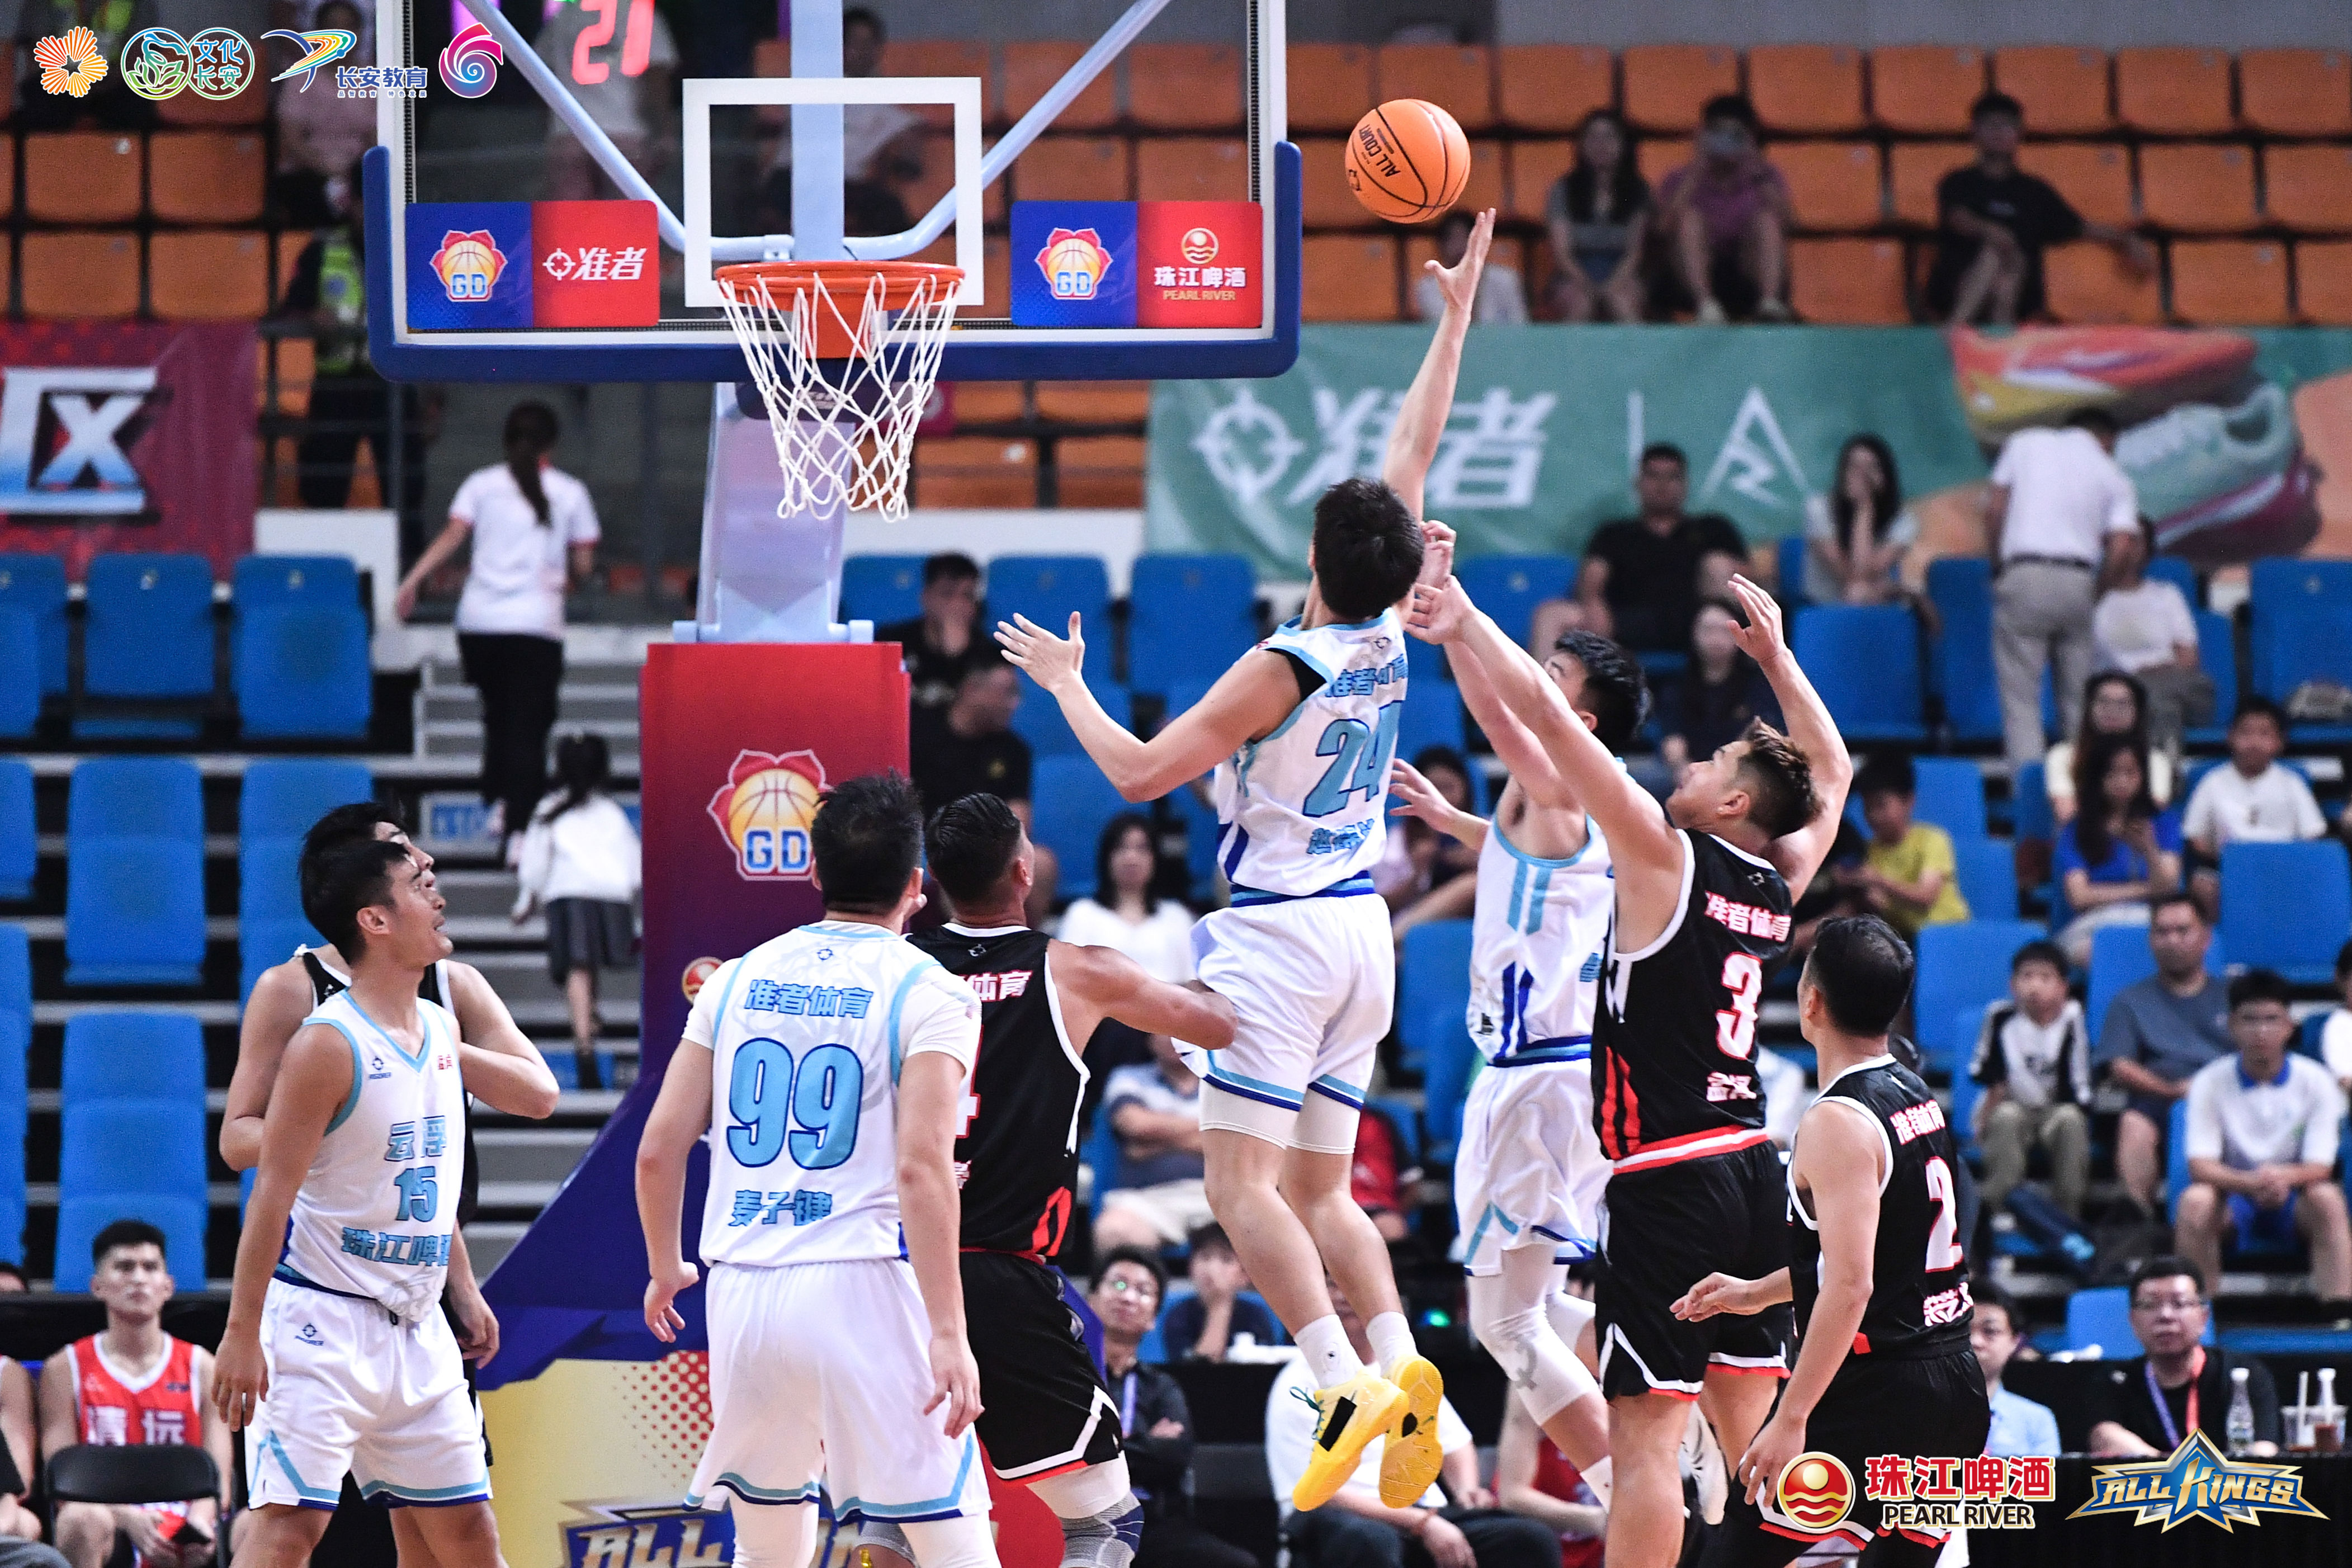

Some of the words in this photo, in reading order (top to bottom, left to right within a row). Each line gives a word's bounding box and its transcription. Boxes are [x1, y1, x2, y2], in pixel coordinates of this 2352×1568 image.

[1376, 153, 1401, 177] ALL
[572, 246, 648, 281] 准者
[1056, 271, 1093, 294] GD
[1154, 266, 1247, 288] 珠江啤酒
[451, 273, 488, 297] GD
[1163, 290, 1201, 301] PEARL
[1202, 290, 1236, 301] RIVER
[1302, 699, 1403, 818] 24
[745, 829, 807, 870] GD
[744, 979, 873, 1019] 准者体育
[958, 970, 1033, 1003] 体育
[1715, 951, 1763, 1060] 3
[726, 1037, 864, 1170] 99
[1889, 1099, 1946, 1146] 准者体育
[394, 1165, 437, 1222] 15
[1925, 1155, 1964, 1273] 2
[577, 1519, 731, 1568] ALL
